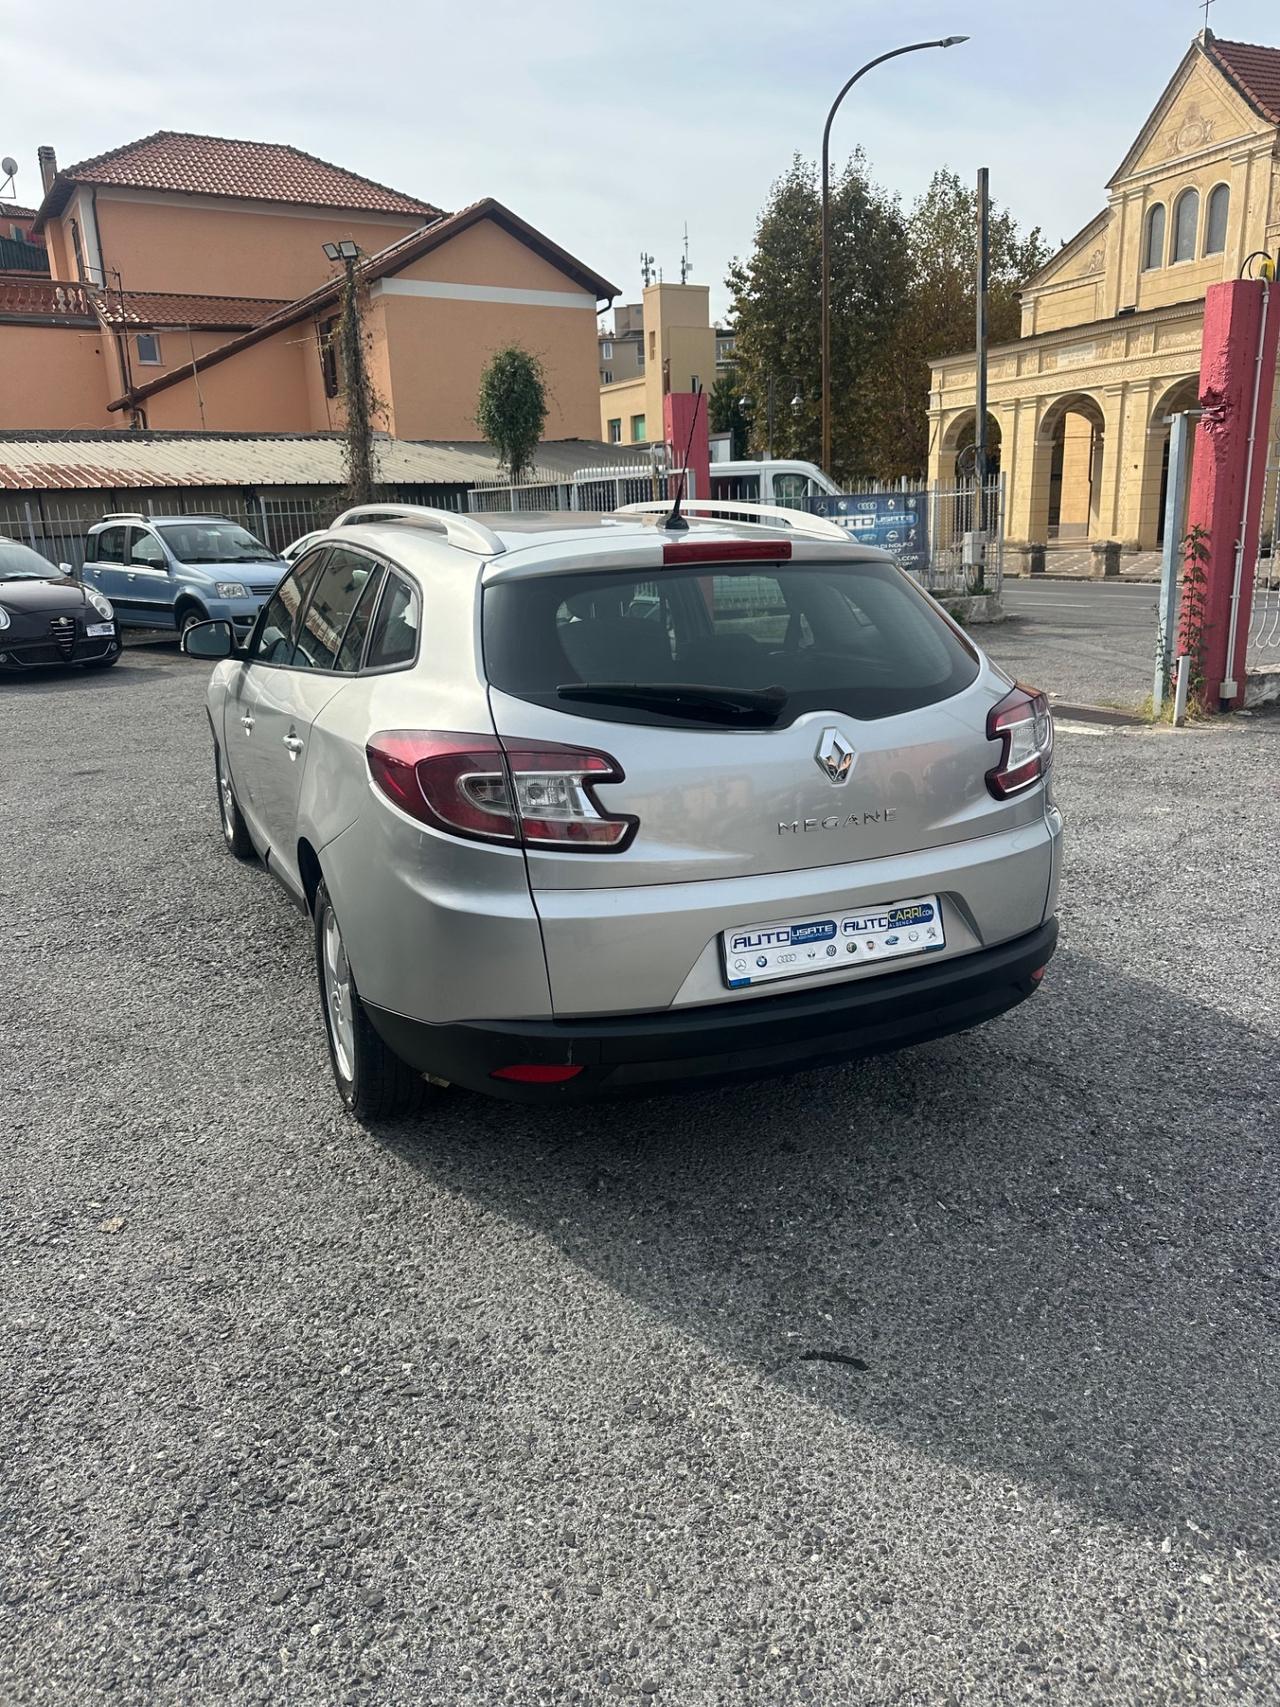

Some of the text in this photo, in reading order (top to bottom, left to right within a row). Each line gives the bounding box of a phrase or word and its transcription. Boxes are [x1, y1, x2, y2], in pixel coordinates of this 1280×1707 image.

[831, 517, 874, 527] UTO
[777, 808, 897, 835] MEGANE
[733, 930, 790, 949] AUTO
[791, 924, 834, 938] USATE
